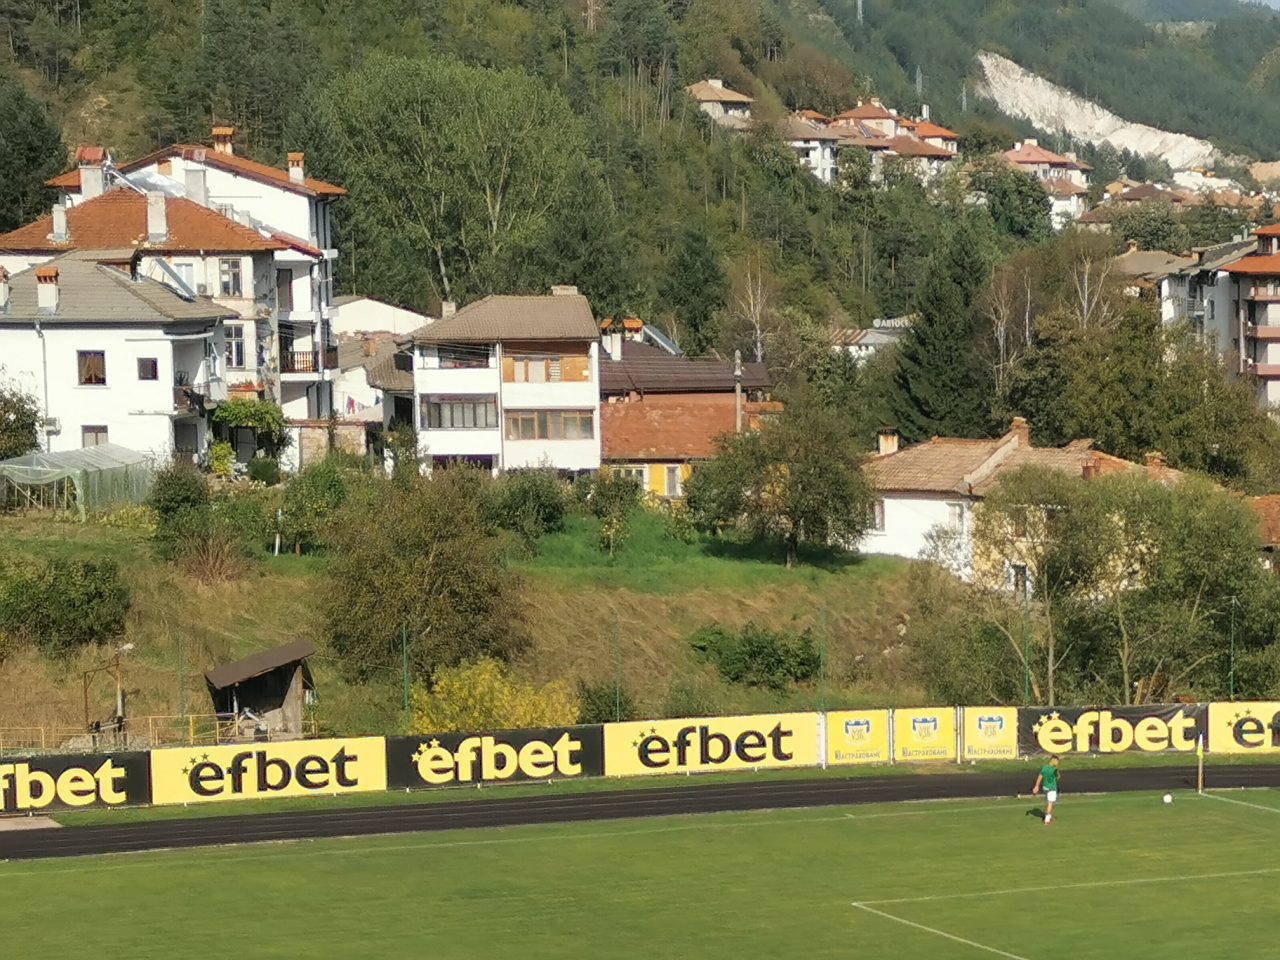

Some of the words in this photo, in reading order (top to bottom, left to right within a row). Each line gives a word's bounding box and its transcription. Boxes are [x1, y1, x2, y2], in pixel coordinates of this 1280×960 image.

[638, 722, 793, 768] efbet
[1037, 709, 1197, 753] efbet
[188, 746, 358, 796] efbet
[417, 732, 582, 785] efbet
[0, 758, 126, 810] fbet
